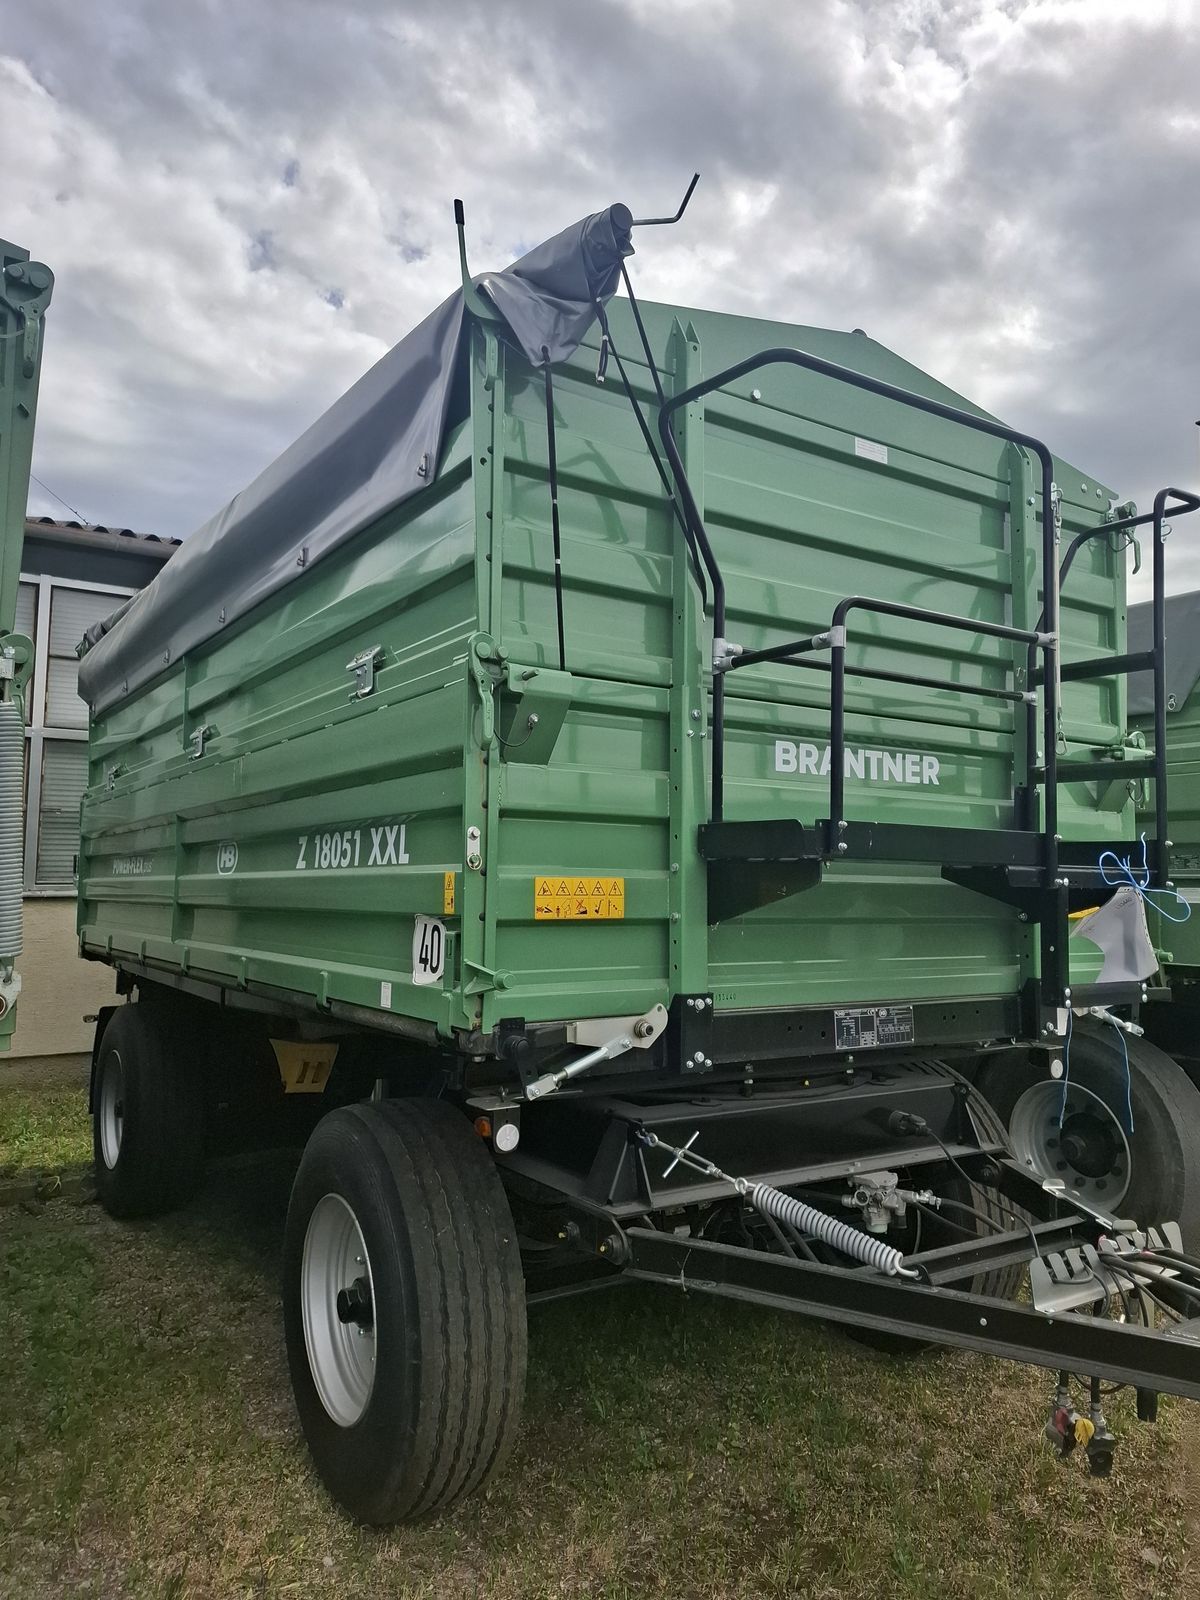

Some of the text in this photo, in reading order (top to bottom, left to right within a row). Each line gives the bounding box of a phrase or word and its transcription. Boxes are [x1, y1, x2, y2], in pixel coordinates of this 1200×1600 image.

[296, 824, 410, 869] Z 18051 XXL
[419, 923, 441, 974] 40
